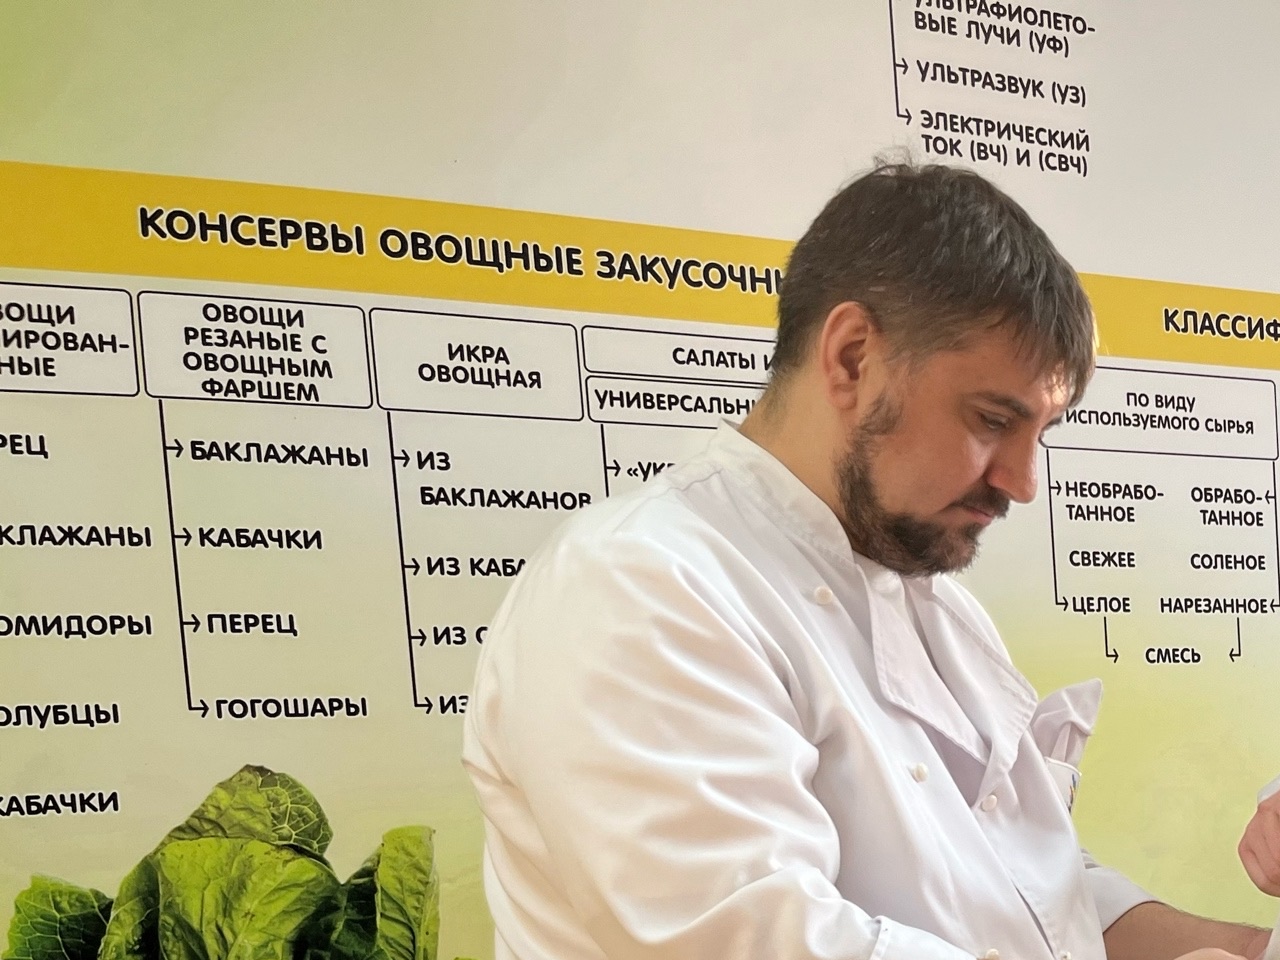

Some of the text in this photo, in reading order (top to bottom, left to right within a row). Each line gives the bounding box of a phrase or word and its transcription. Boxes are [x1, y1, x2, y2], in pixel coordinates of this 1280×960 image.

[914, 11, 1070, 58] ВЫЕ ЛУЧИ (УФ)
[916, 60, 1086, 107] УЛЬТРАЗВУК (УЗ)
[920, 110, 1090, 152] ЭЛЕКТРИЧЕСКИЙ
[921, 134, 1088, 177] ТОК (ВЧ) И (СВЧ)
[139, 207, 364, 255] КОНСЕРВЫ
[381, 230, 584, 277] ОВОЩНЫЕ
[203, 303, 304, 329] ОВОЩИ
[2, 329, 129, 353] ИРОВАН-
[184, 327, 327, 354] РЕЗАНЫЕ С
[183, 352, 332, 378] ОВОЩНЫМ
[448, 343, 509, 364] ИКРА
[672, 347, 755, 370] САЛАТЫ
[0, 356, 56, 377] НЫЕ
[418, 363, 541, 389] ОВОЩНАЯ
[202, 379, 319, 402] ФАРШЕМ
[595, 389, 757, 415] УНИВЕРСАЛЬН
[1126, 392, 1196, 413] ПО ВИДУ
[1065, 410, 1254, 435] ИСПОЛЬЗУЕМОГО СЫРЬЯ
[190, 440, 369, 468] БАКЛАЖАНЫ
[417, 451, 451, 471] ИЗ
[420, 487, 592, 510] БАКЛАЖАНОВ
[1065, 481, 1164, 501] НЕОБРАБО-
[1190, 487, 1263, 505] ОБРАБО-
[1066, 504, 1135, 522] ТАННОЕ
[1200, 509, 1264, 527] ТАННОЕ
[0, 525, 152, 547] КЛАЖАНЫ
[198, 530, 323, 550] КАБАЧКИ
[426, 557, 461, 576] ИЗ
[1069, 550, 1136, 568] СВЕЖЕЕ
[1190, 553, 1266, 570] СОЛЕНОЕ
[1072, 596, 1131, 615] ЦЕЛОЕ
[1160, 598, 1268, 614] НАРЕЗАННОЕ
[0, 616, 152, 639] ОМИДОРЫ
[207, 612, 298, 637] ПЕРЕЦ
[433, 626, 467, 646] ИЗ
[1145, 648, 1201, 664] СМЕСЬ
[0, 704, 119, 728] ОЛУБЦЫ
[215, 698, 368, 719] ГОГОШАРЫ
